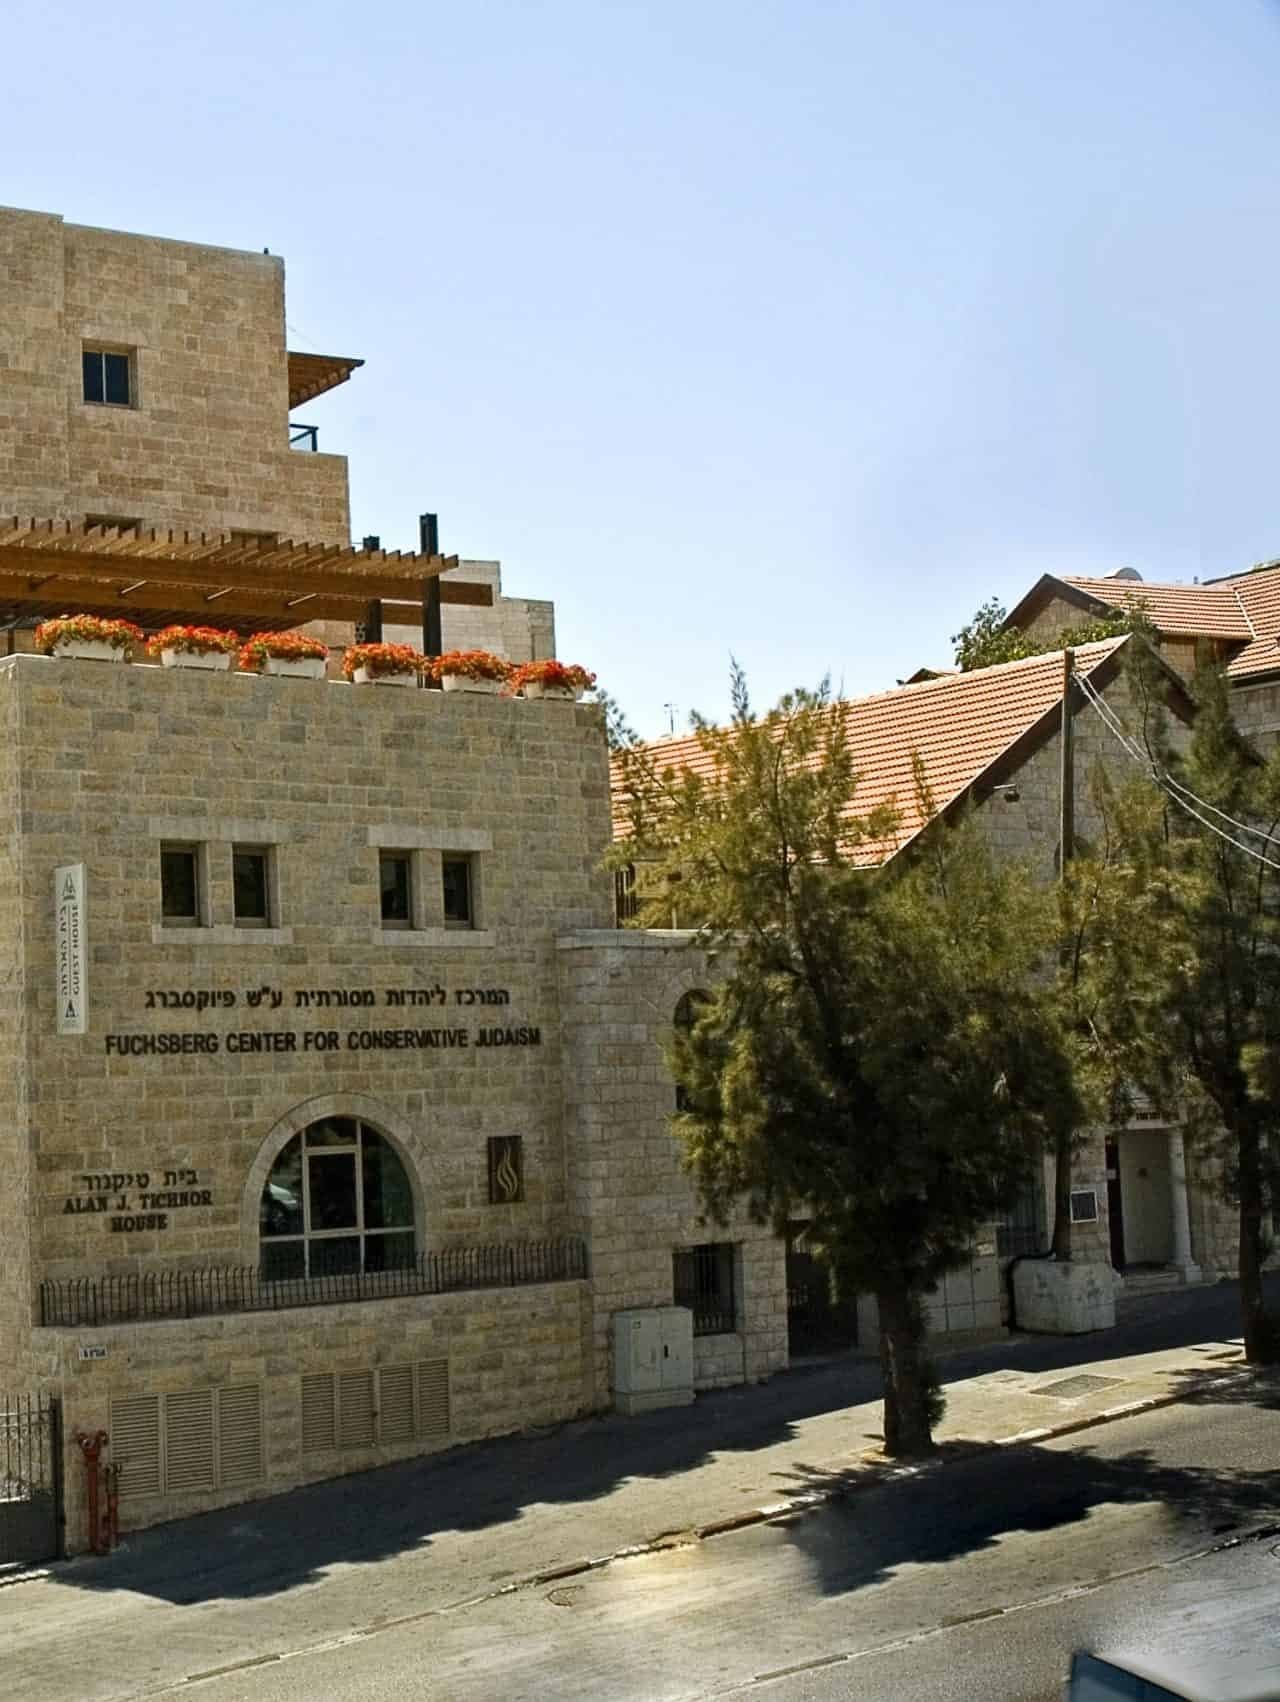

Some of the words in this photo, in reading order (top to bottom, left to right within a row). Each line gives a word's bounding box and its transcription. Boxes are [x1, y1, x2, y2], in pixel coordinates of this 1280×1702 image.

[72, 904, 80, 949] HOUSE
[60, 940, 68, 996] הארחה
[72, 956, 80, 996] GUEST
[144, 989, 237, 1012] פיוקסברג
[294, 989, 376, 1008] מסורתית
[385, 983, 446, 1007] ליהדות
[454, 989, 510, 1006] המרכז
[104, 1032, 219, 1056] FUCHSBERG
[226, 1031, 297, 1054] CENTER
[303, 1031, 341, 1052] FOR
[347, 1028, 469, 1051] CONSERVATIVE
[475, 1026, 540, 1048] JUDAISM
[81, 1172, 150, 1193] טיקנור
[163, 1169, 199, 1187] בית
[62, 1195, 109, 1214] ALAN
[116, 1194, 132, 1212] J.
[139, 1189, 214, 1210] TICHNOR
[111, 1213, 169, 1233] HOUSE
